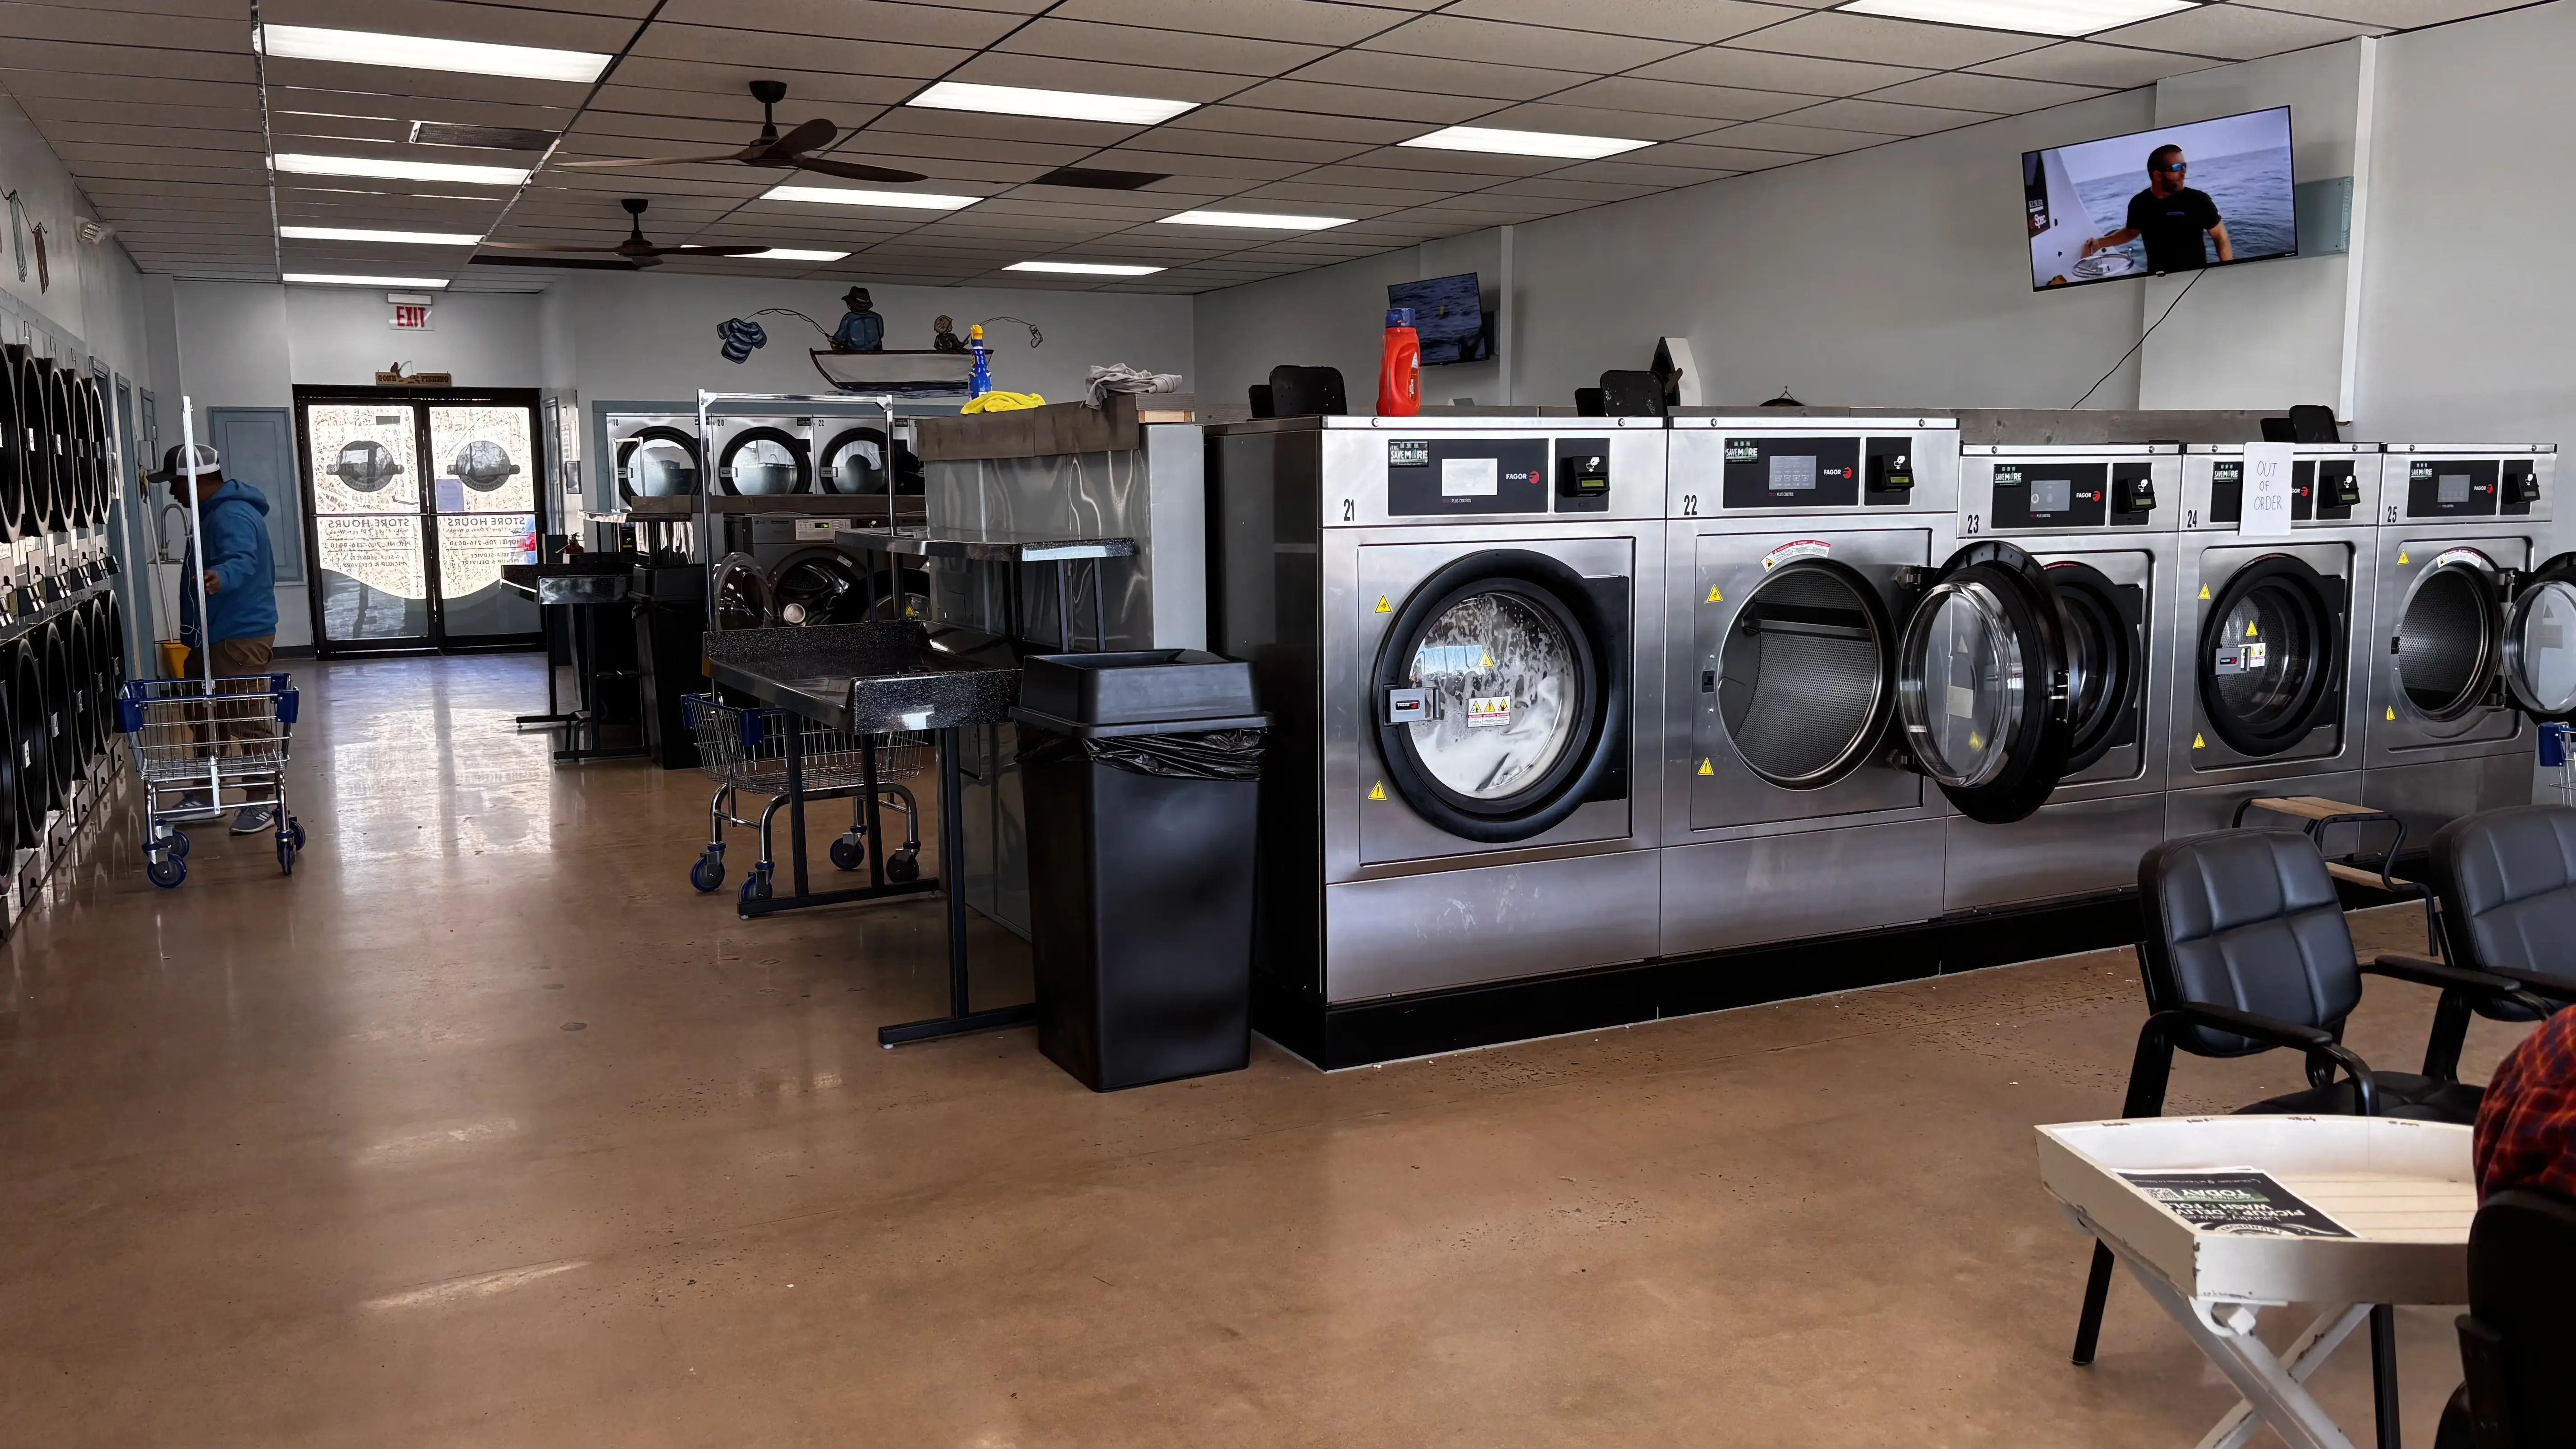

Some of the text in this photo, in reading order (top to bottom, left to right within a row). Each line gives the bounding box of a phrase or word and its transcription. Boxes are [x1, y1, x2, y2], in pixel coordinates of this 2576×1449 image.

[396, 306, 426, 327] EXIT
[2257, 460, 2277, 477] OUT
[2259, 481, 2269, 492] OF
[1343, 499, 1354, 521] 21
[1684, 495, 1697, 515] 22
[2254, 495, 2282, 510] ORDER
[2187, 510, 2197, 528] 24
[2387, 506, 2397, 523] 25
[1967, 515, 1979, 534] 23
